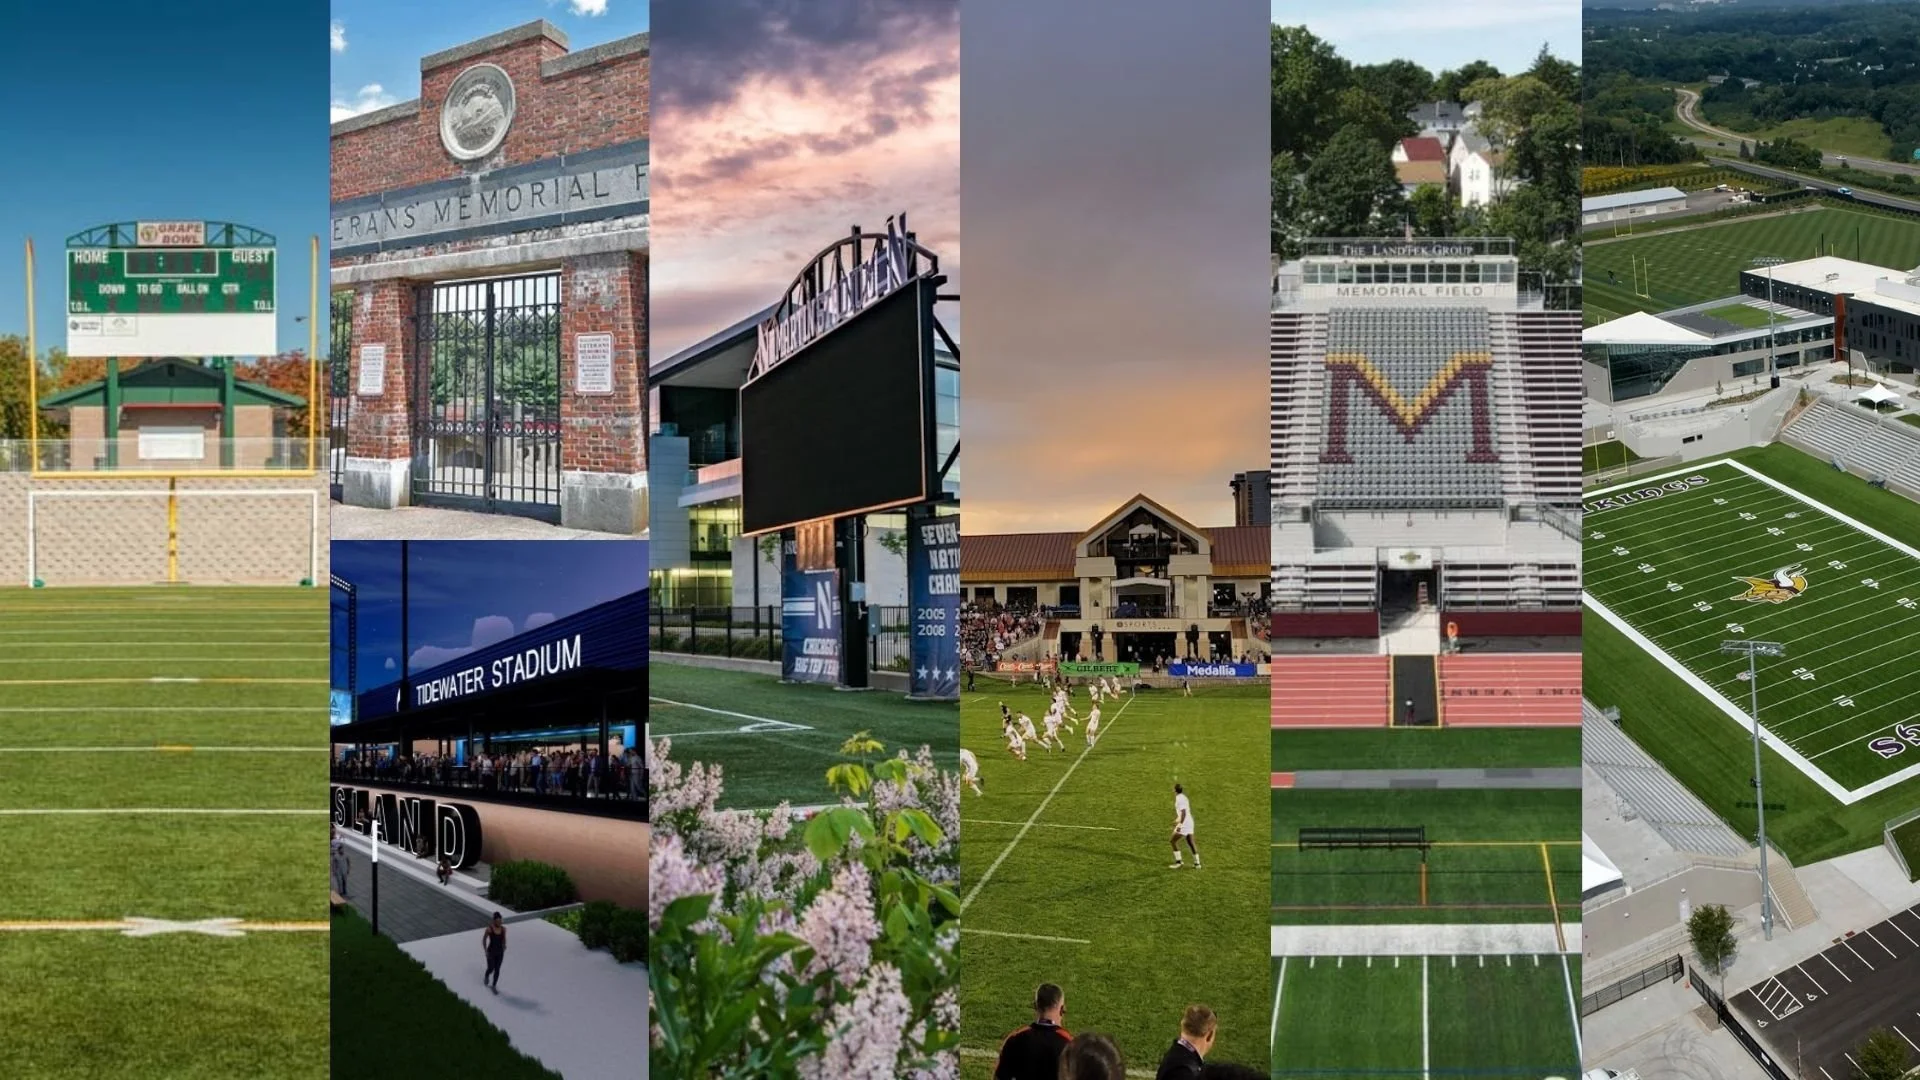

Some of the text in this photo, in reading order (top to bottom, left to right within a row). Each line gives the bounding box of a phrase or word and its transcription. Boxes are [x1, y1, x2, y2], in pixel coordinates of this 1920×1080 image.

[434, 172, 610, 225] MEMORIAL
[158, 223, 202, 234] GRAPE
[162, 234, 200, 244] BOWL
[1341, 245, 1366, 256] THE
[1432, 244, 1474, 256] GROUP
[74, 251, 109, 264] HOME
[231, 251, 270, 264] GUEST
[98, 283, 126, 295] DOWN
[136, 283, 163, 295] TO GO
[176, 283, 209, 295] BALL ON
[1337, 286, 1484, 297] MEMORIAL FIELD
[1319, 353, 1500, 464] M
[816, 581, 832, 630] N
[917, 608, 946, 620] 2005
[917, 624, 946, 636] 2008
[416, 634, 581, 706] TIDEWATER STADIUM
[1076, 665, 1118, 673] GILBERT
[1187, 664, 1236, 676] Medallia
[1792, 667, 1815, 680] 20
[1833, 695, 1854, 707] 10
[335, 787, 470, 870] SLAND
